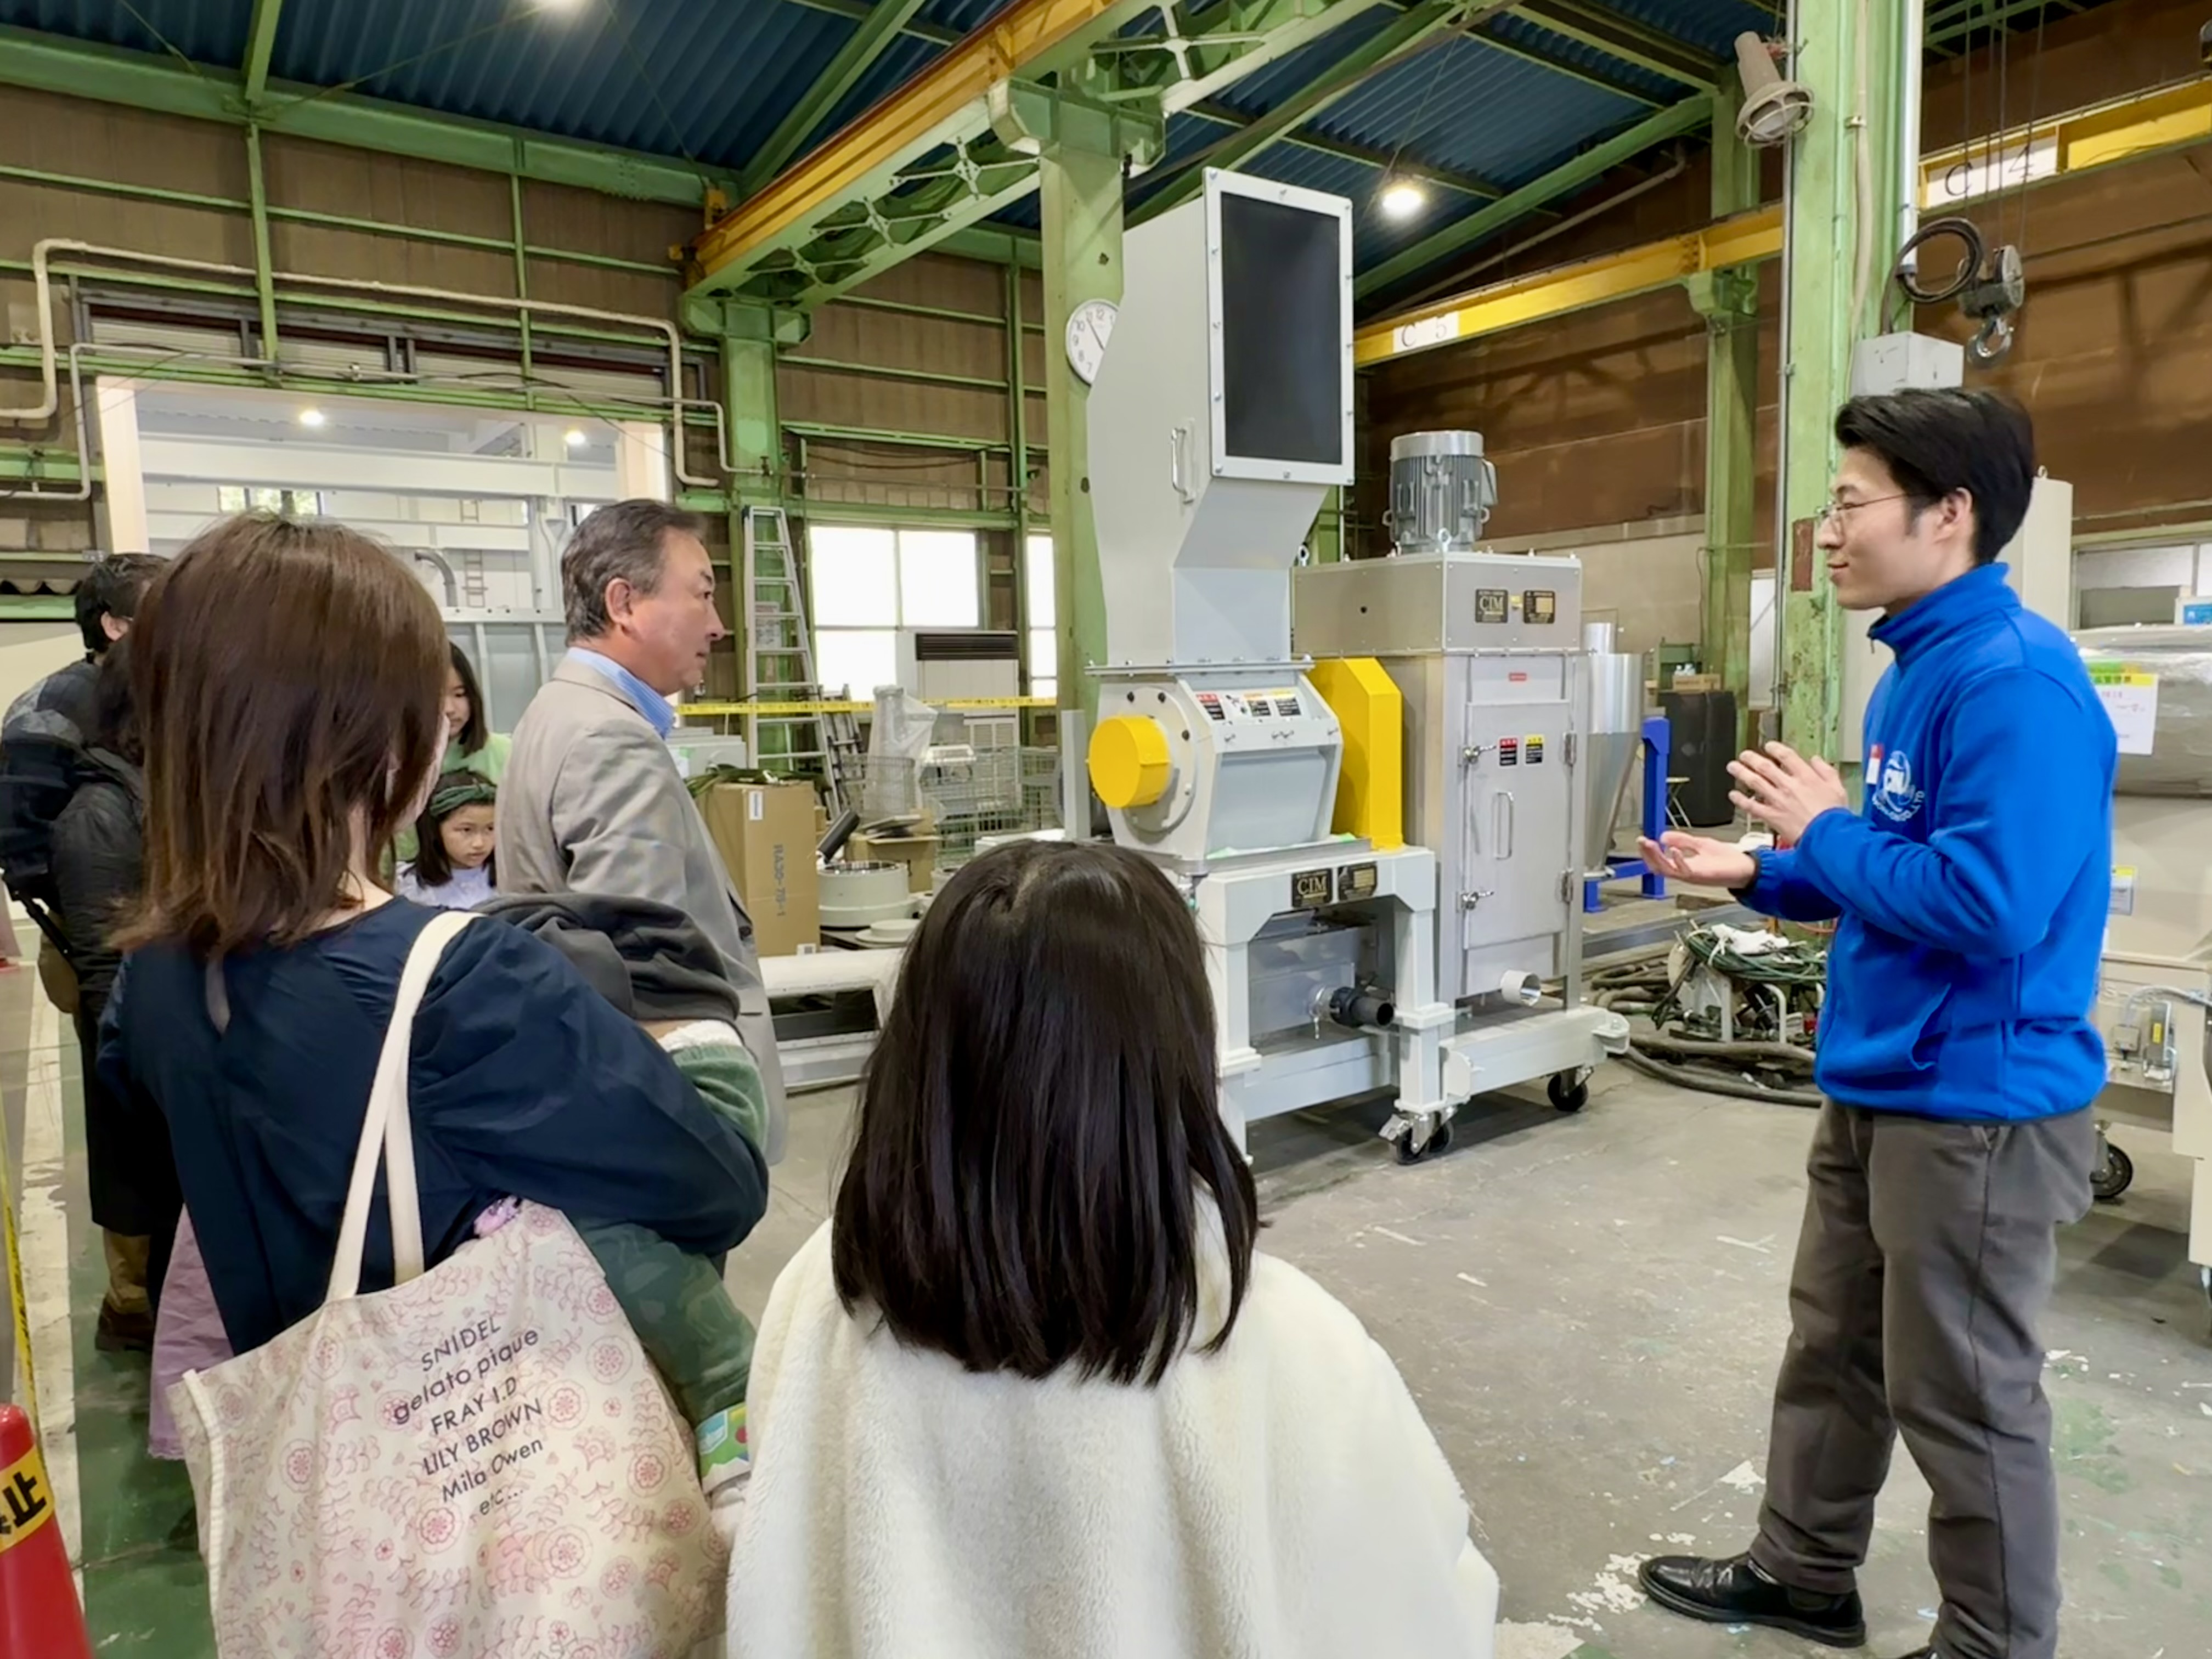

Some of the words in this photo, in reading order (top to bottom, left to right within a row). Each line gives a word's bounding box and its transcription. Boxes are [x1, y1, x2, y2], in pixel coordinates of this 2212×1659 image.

[1296, 876, 1327, 895] CIM
[421, 1317, 501, 1372] SNIDEL
[394, 1368, 471, 1425] gelato
[477, 1329, 539, 1379] pique
[431, 1392, 485, 1435] FRAY
[493, 1376, 517, 1404] I.D
[423, 1444, 459, 1476] LILY
[465, 1398, 542, 1454] BROWN
[442, 1470, 487, 1503] Mila
[492, 1438, 543, 1475] Owen
